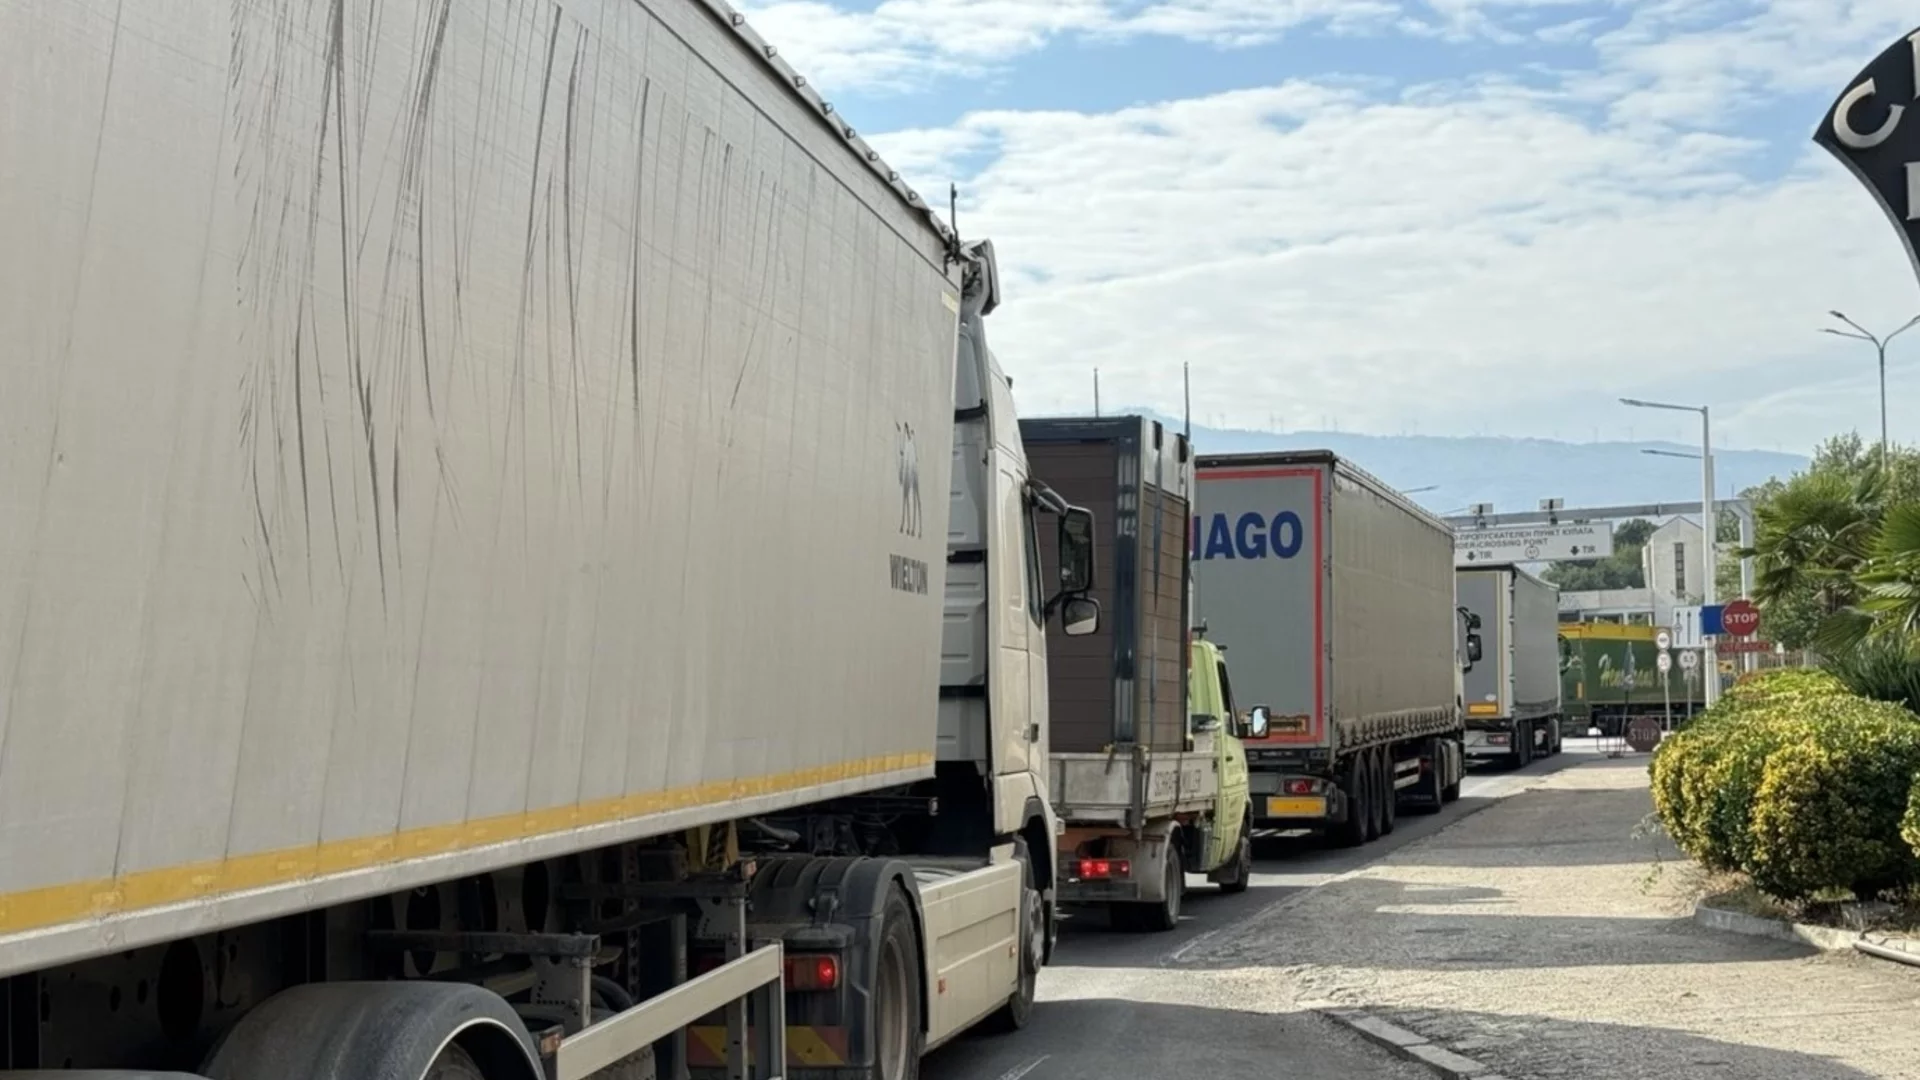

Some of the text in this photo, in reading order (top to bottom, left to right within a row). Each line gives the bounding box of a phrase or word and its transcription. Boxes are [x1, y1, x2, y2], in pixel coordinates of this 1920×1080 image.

[1480, 551, 1493, 559] TIR
[1582, 545, 1597, 554] TIR
[889, 553, 929, 596] WIELTON
[1725, 612, 1758, 624] STOP
[1630, 728, 1657, 741] STOP
